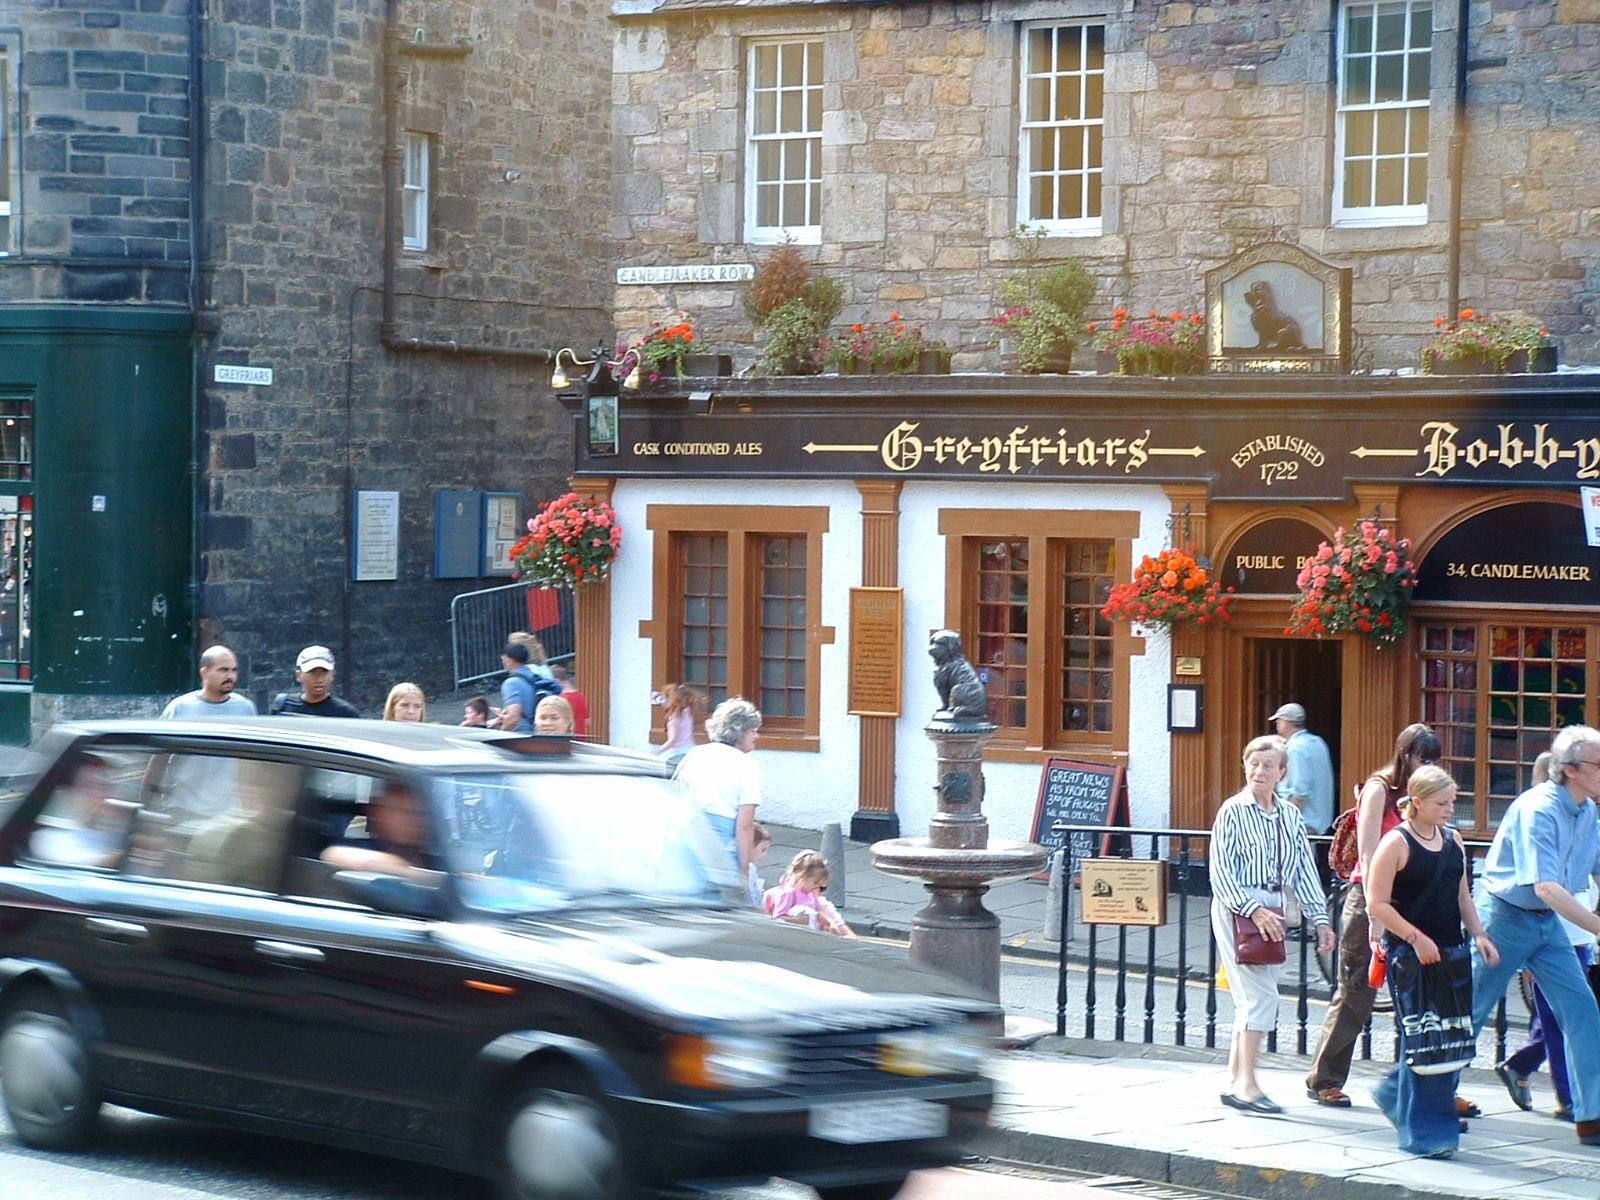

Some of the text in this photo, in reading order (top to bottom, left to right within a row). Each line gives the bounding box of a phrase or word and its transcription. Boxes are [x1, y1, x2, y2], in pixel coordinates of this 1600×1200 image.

[620, 265, 750, 283] CANDLEMAKER ROW
[218, 368, 270, 382] GREYFRIARS
[633, 442, 763, 456] CASK CONDITIONED ALES
[881, 420, 1151, 474] Greyfriars
[1230, 434, 1325, 469] ESTABLISHED
[1260, 460, 1299, 486] 1722
[1236, 555, 1285, 569] PUBLIC
[1470, 563, 1592, 582] CANDLEMAKER
[1049, 769, 1110, 788] GREAT NEWS
[1049, 784, 1108, 800] AS FROM THE
[1060, 797, 1073, 808] OF
[1072, 798, 1108, 812] AUGUST
